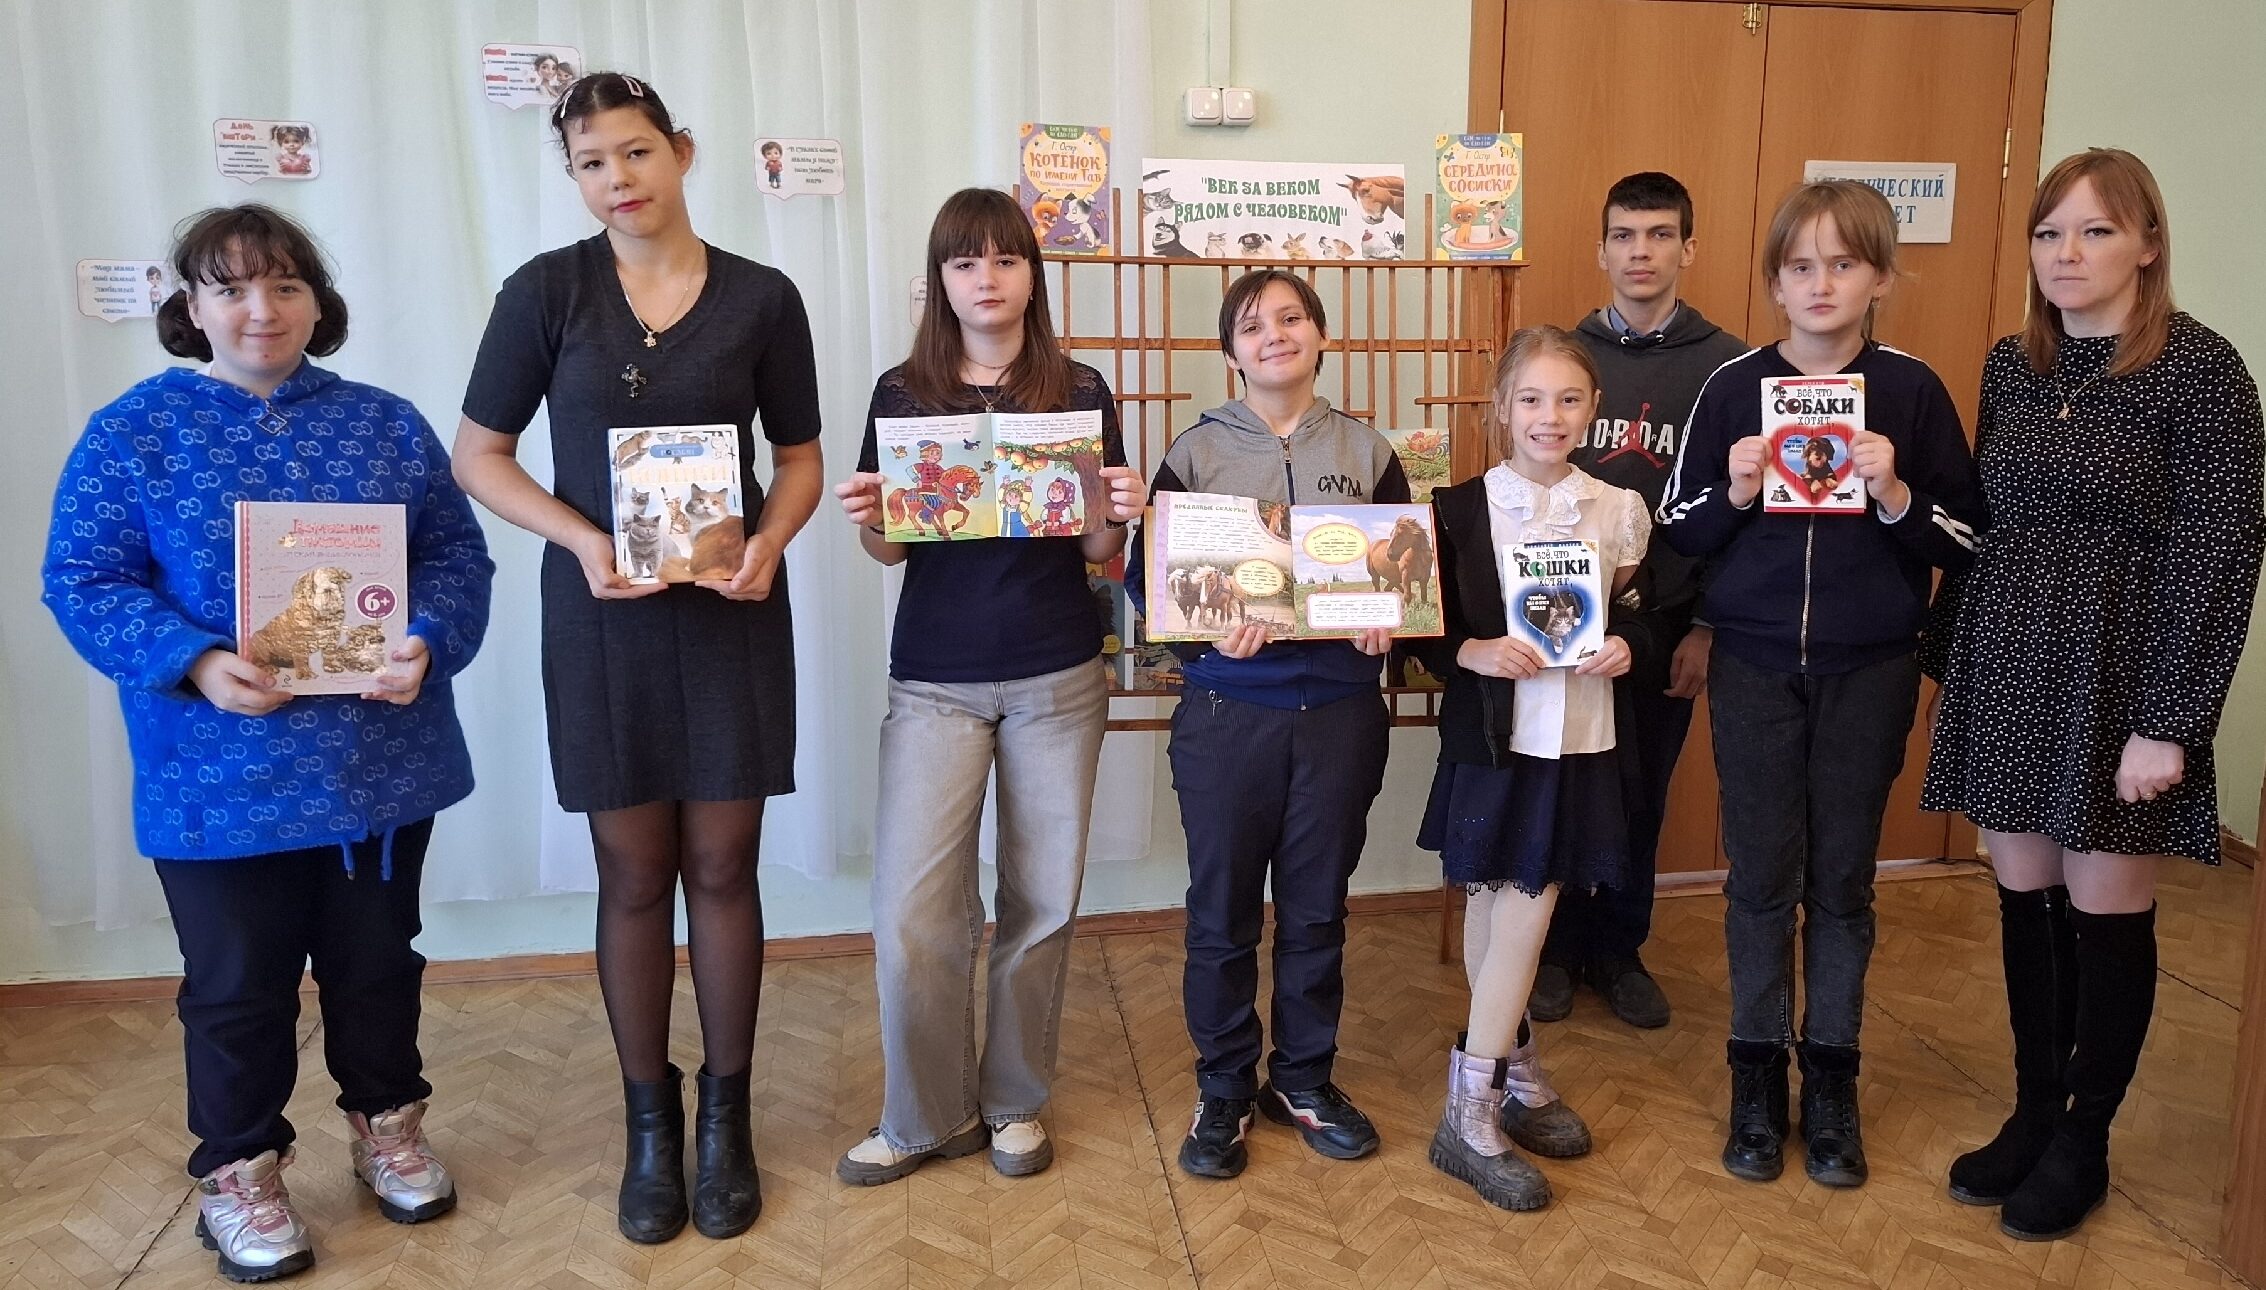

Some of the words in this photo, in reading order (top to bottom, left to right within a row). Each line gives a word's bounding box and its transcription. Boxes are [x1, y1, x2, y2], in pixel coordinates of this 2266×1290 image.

[1029, 151, 1102, 170] КОТЁНОК
[1266, 178, 1321, 196] ВЕКОМ
[1174, 203, 1230, 224] РЯДОМ
[1232, 202, 1243, 217] С
[1774, 398, 1855, 415] СОБАКИ
[1518, 559, 1591, 578] КОШКИ
[364, 591, 391, 612] 6+
